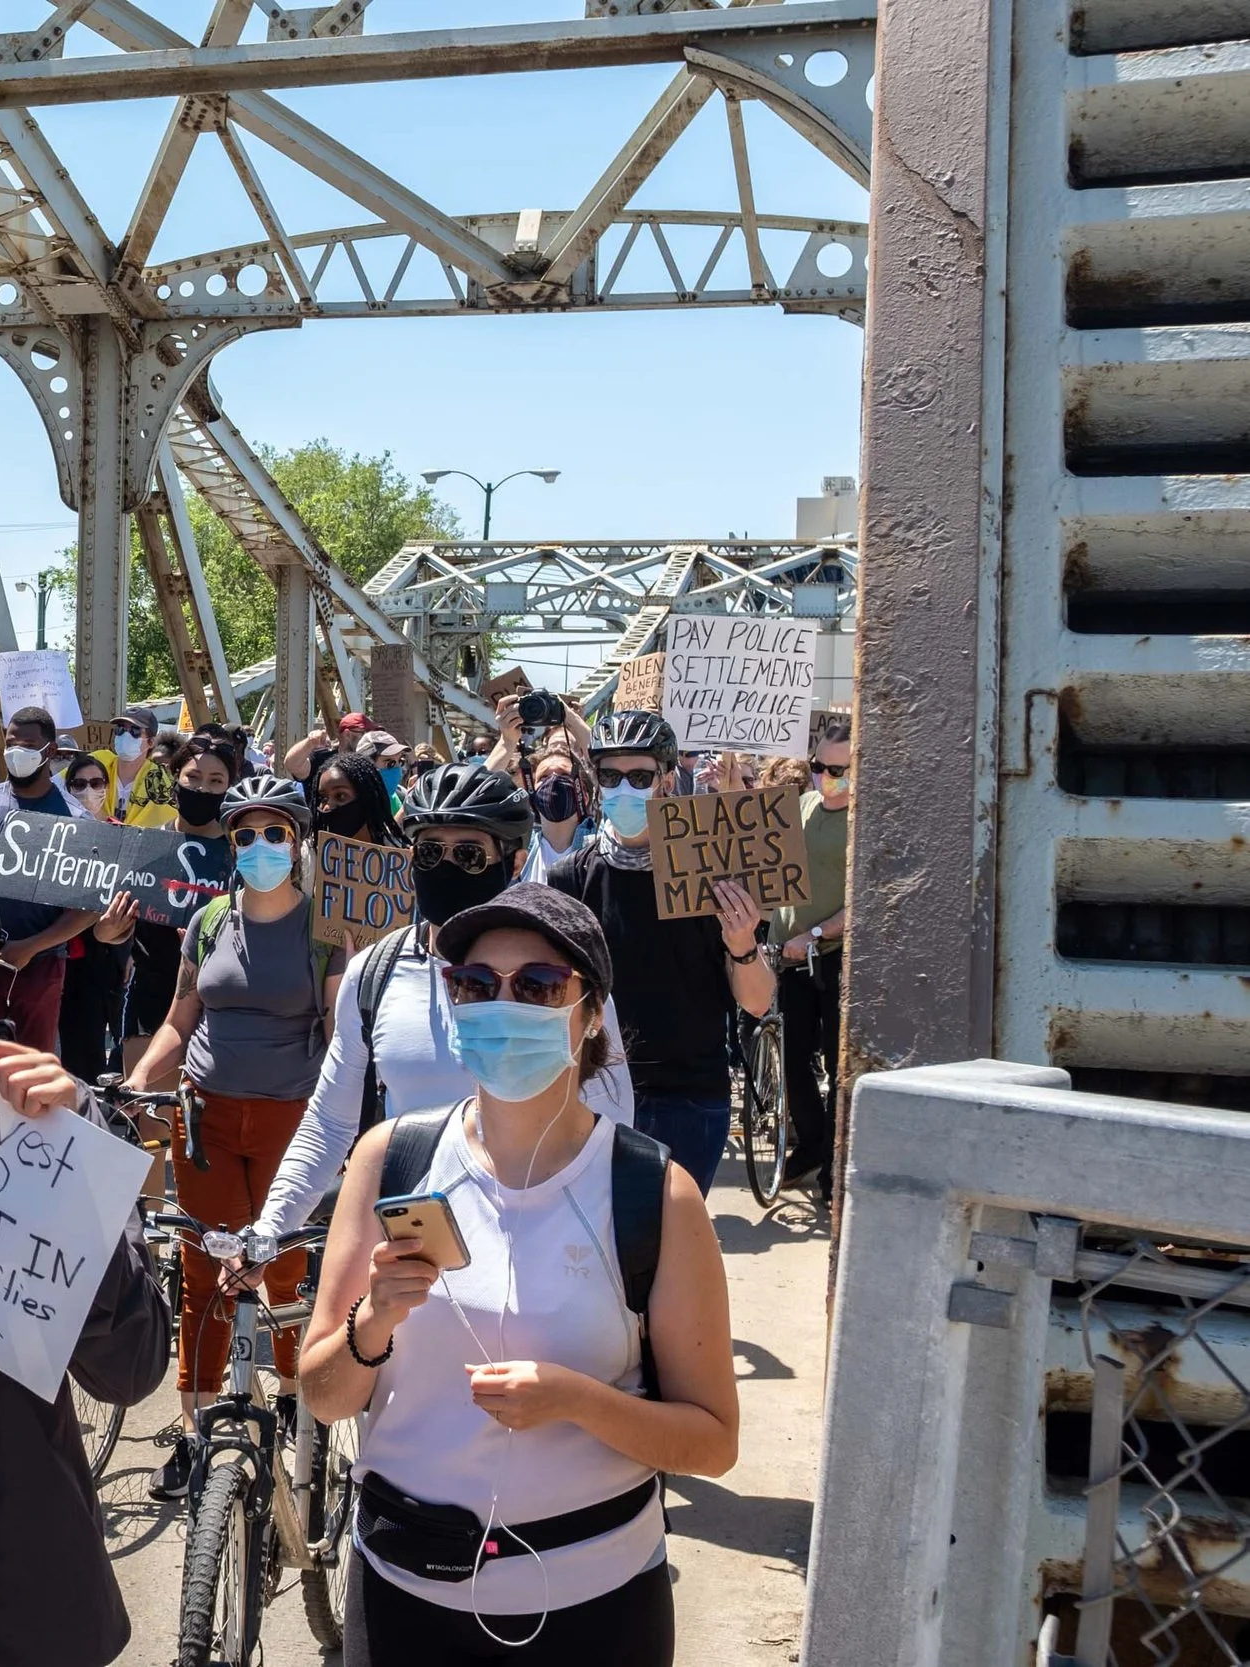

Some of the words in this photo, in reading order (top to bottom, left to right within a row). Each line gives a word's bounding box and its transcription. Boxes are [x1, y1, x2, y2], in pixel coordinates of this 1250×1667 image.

[672, 618, 716, 651] PAY
[727, 621, 813, 654] POLICE
[623, 657, 666, 681] SILEN
[669, 654, 814, 688] SETTLEMENTS
[670, 689, 724, 711] WITH
[732, 690, 807, 717] POLICE
[685, 712, 799, 743] PENSIONS
[659, 792, 791, 841] BLACK
[666, 831, 782, 879] LIVES
[121, 870, 156, 888] AND
[21, 1233, 85, 1288] IN
